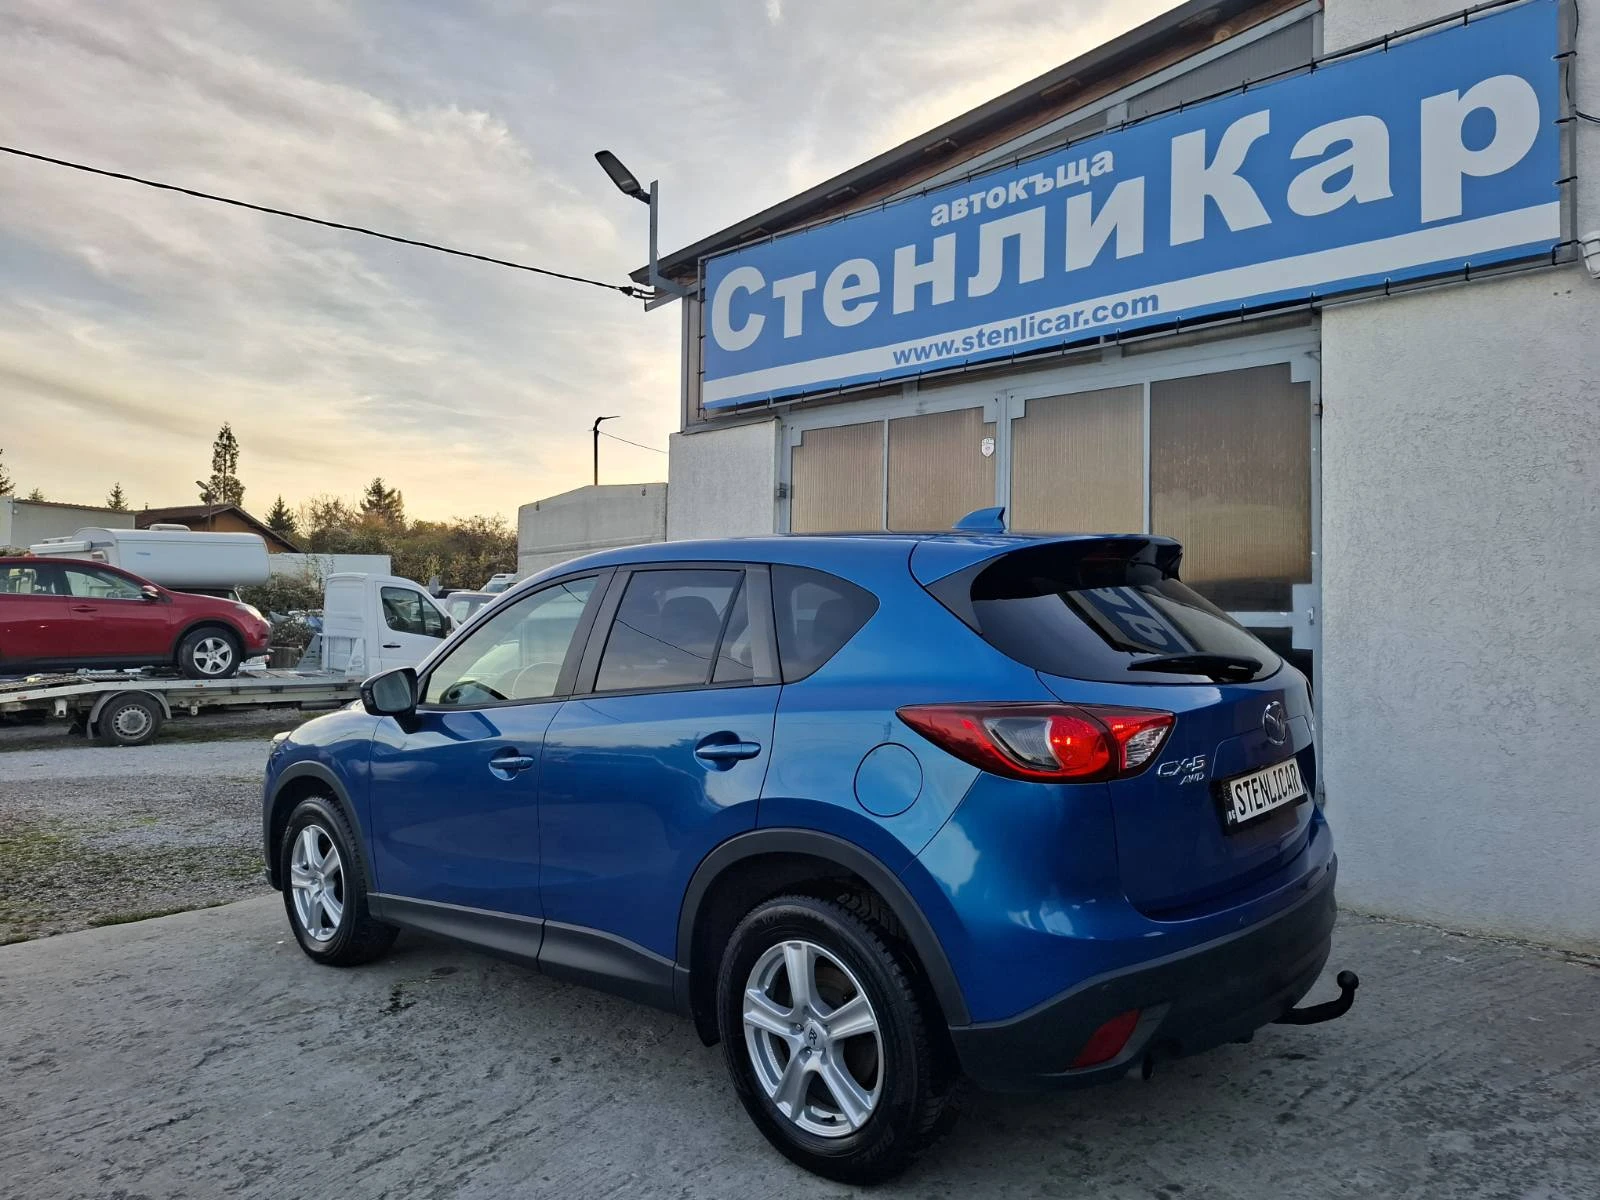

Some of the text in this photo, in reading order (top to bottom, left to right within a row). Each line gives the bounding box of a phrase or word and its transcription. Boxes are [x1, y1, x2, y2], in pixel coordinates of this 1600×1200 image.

[711, 74, 1541, 353] СтенлиКар
[930, 150, 1115, 227] автокъща
[893, 294, 1159, 366] www.stenlicar.com
[1157, 754, 1206, 776] CX-5
[1234, 763, 1300, 816] STENLICAR
